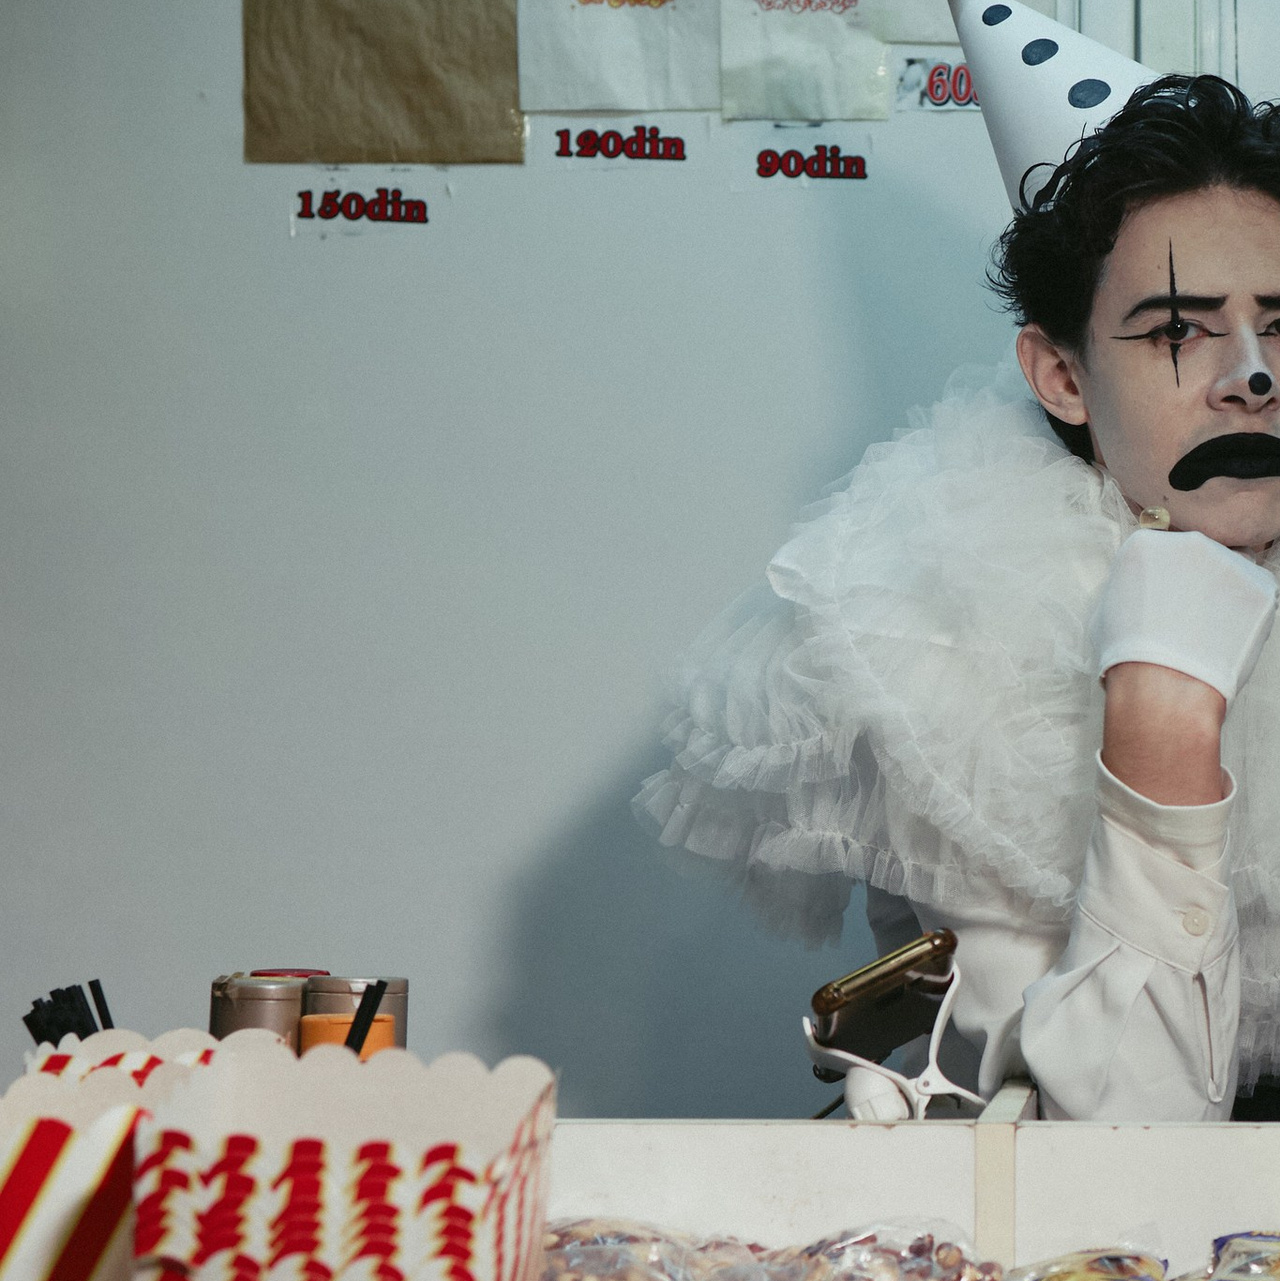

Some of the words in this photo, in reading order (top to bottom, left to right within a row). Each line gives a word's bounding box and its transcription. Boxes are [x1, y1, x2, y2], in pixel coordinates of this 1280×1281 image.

[555, 125, 688, 161] 120din
[756, 144, 868, 180] 90din
[297, 188, 429, 224] 150din
